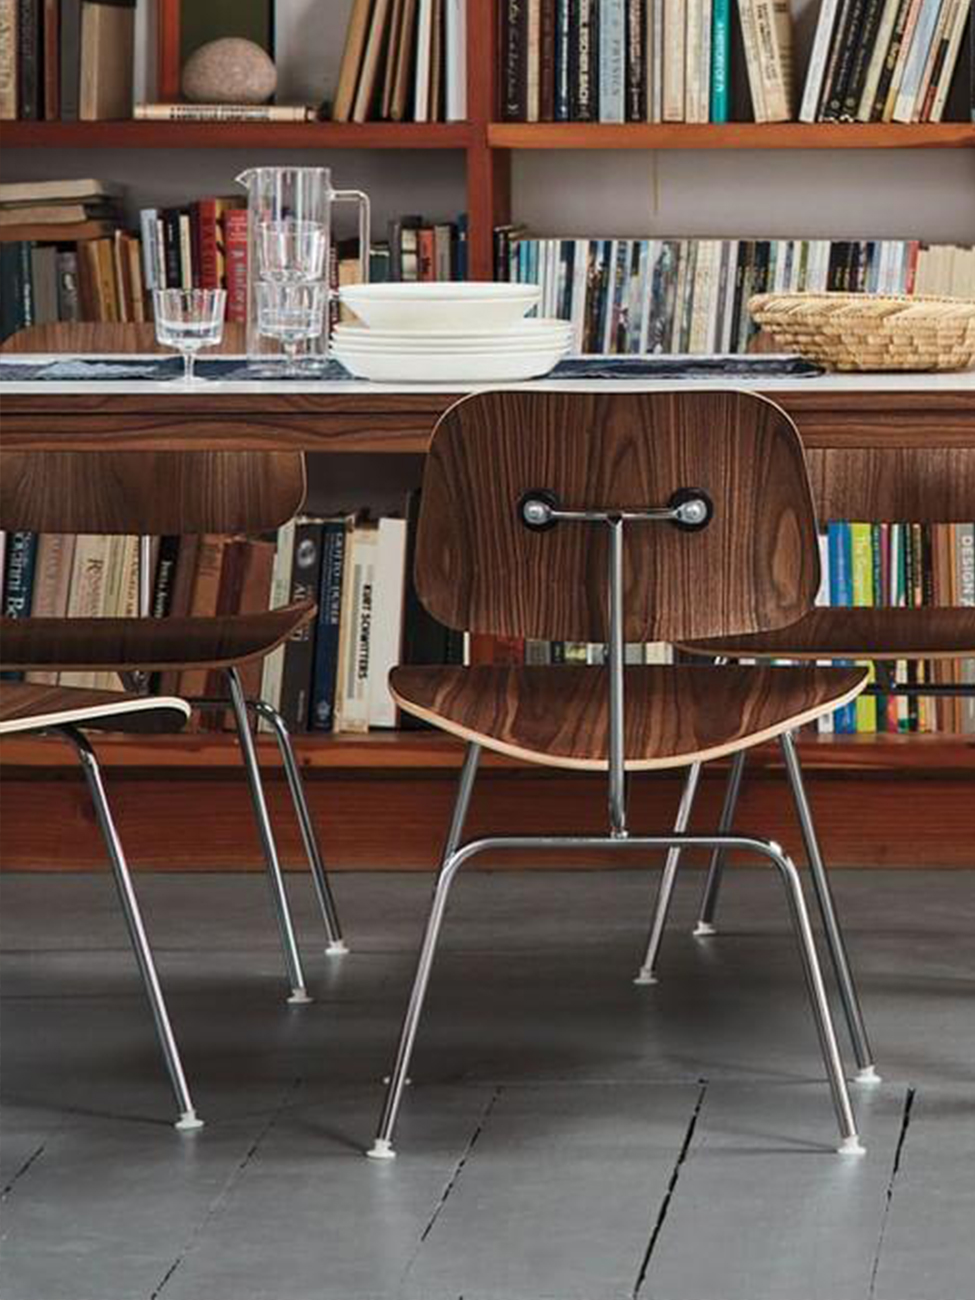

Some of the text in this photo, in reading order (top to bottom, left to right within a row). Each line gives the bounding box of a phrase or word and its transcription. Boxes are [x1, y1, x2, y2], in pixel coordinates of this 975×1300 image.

[961, 535, 975, 595] DESIGN
[358, 583, 372, 679] KURT SCHWITTERS
